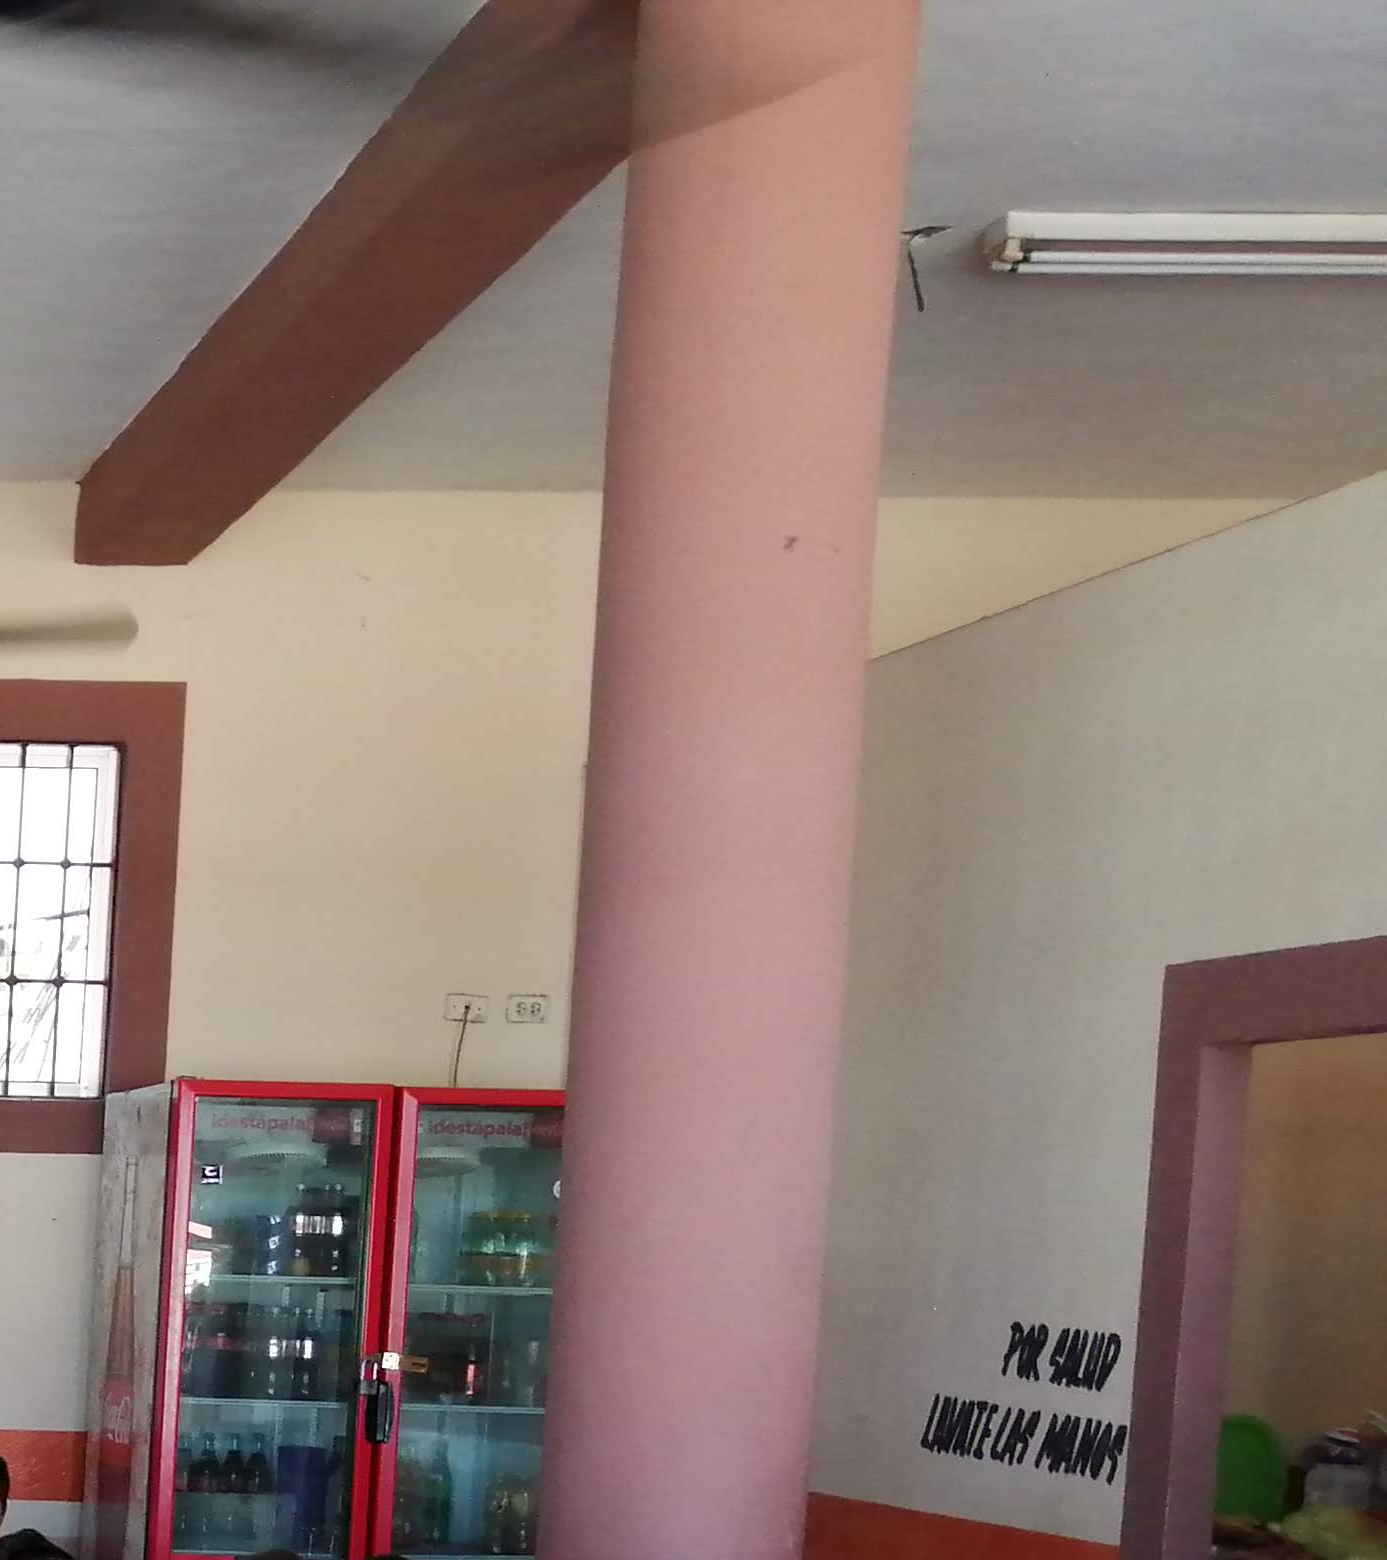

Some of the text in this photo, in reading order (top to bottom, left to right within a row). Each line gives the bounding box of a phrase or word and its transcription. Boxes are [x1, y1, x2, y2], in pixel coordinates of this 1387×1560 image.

[1001, 1321, 1122, 1393] POR SALUD
[990, 1407, 1041, 1467] LAS
[1034, 1413, 1129, 1486] MANOS
